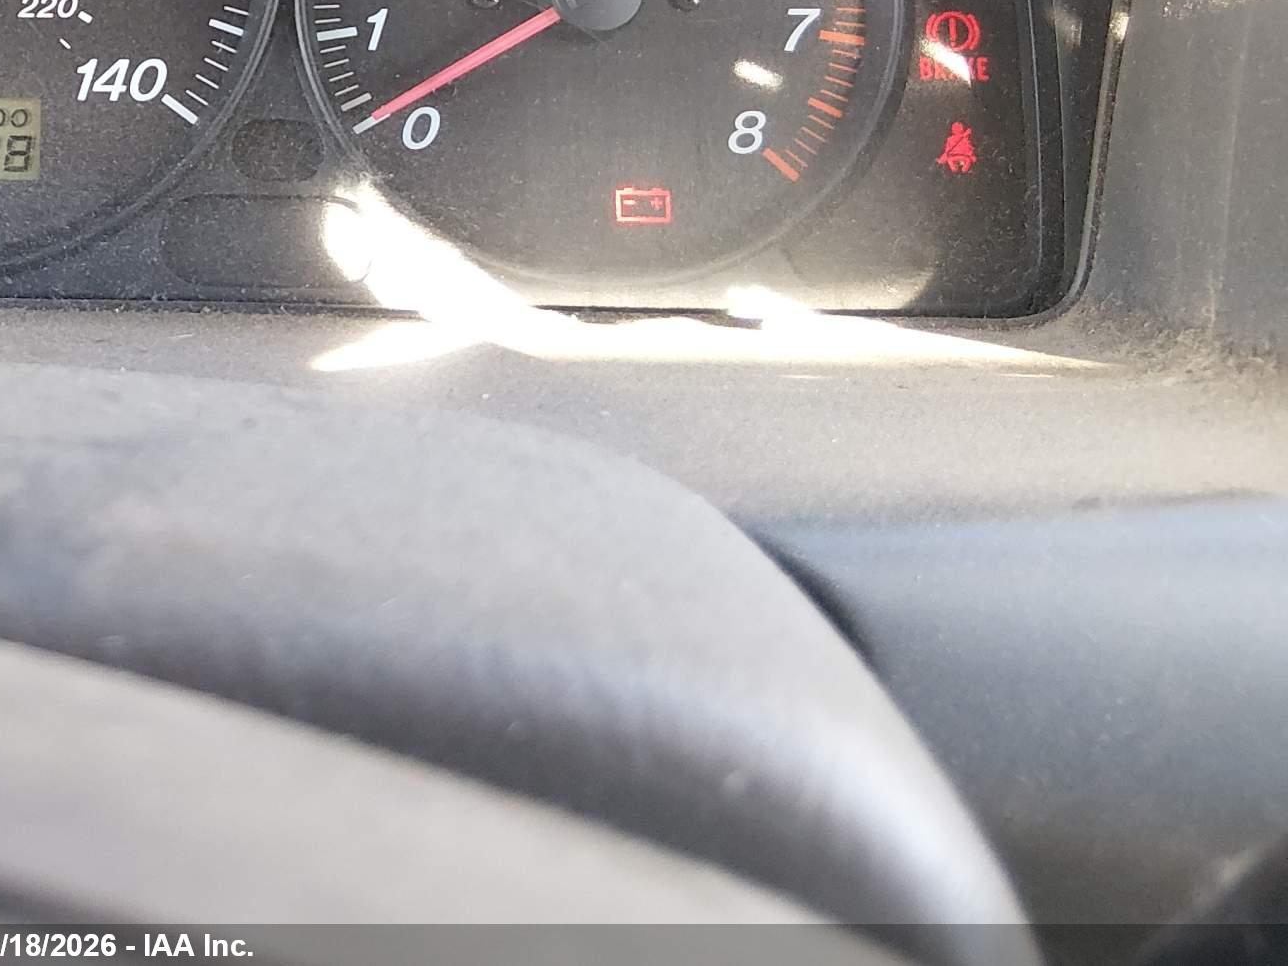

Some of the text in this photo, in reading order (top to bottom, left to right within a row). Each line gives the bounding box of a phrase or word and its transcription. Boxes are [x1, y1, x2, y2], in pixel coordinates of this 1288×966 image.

[367, 9, 387, 50] 1
[784, 9, 821, 51] 7
[77, 59, 167, 101] 140
[403, 107, 440, 149] 0
[728, 111, 766, 154] 8
